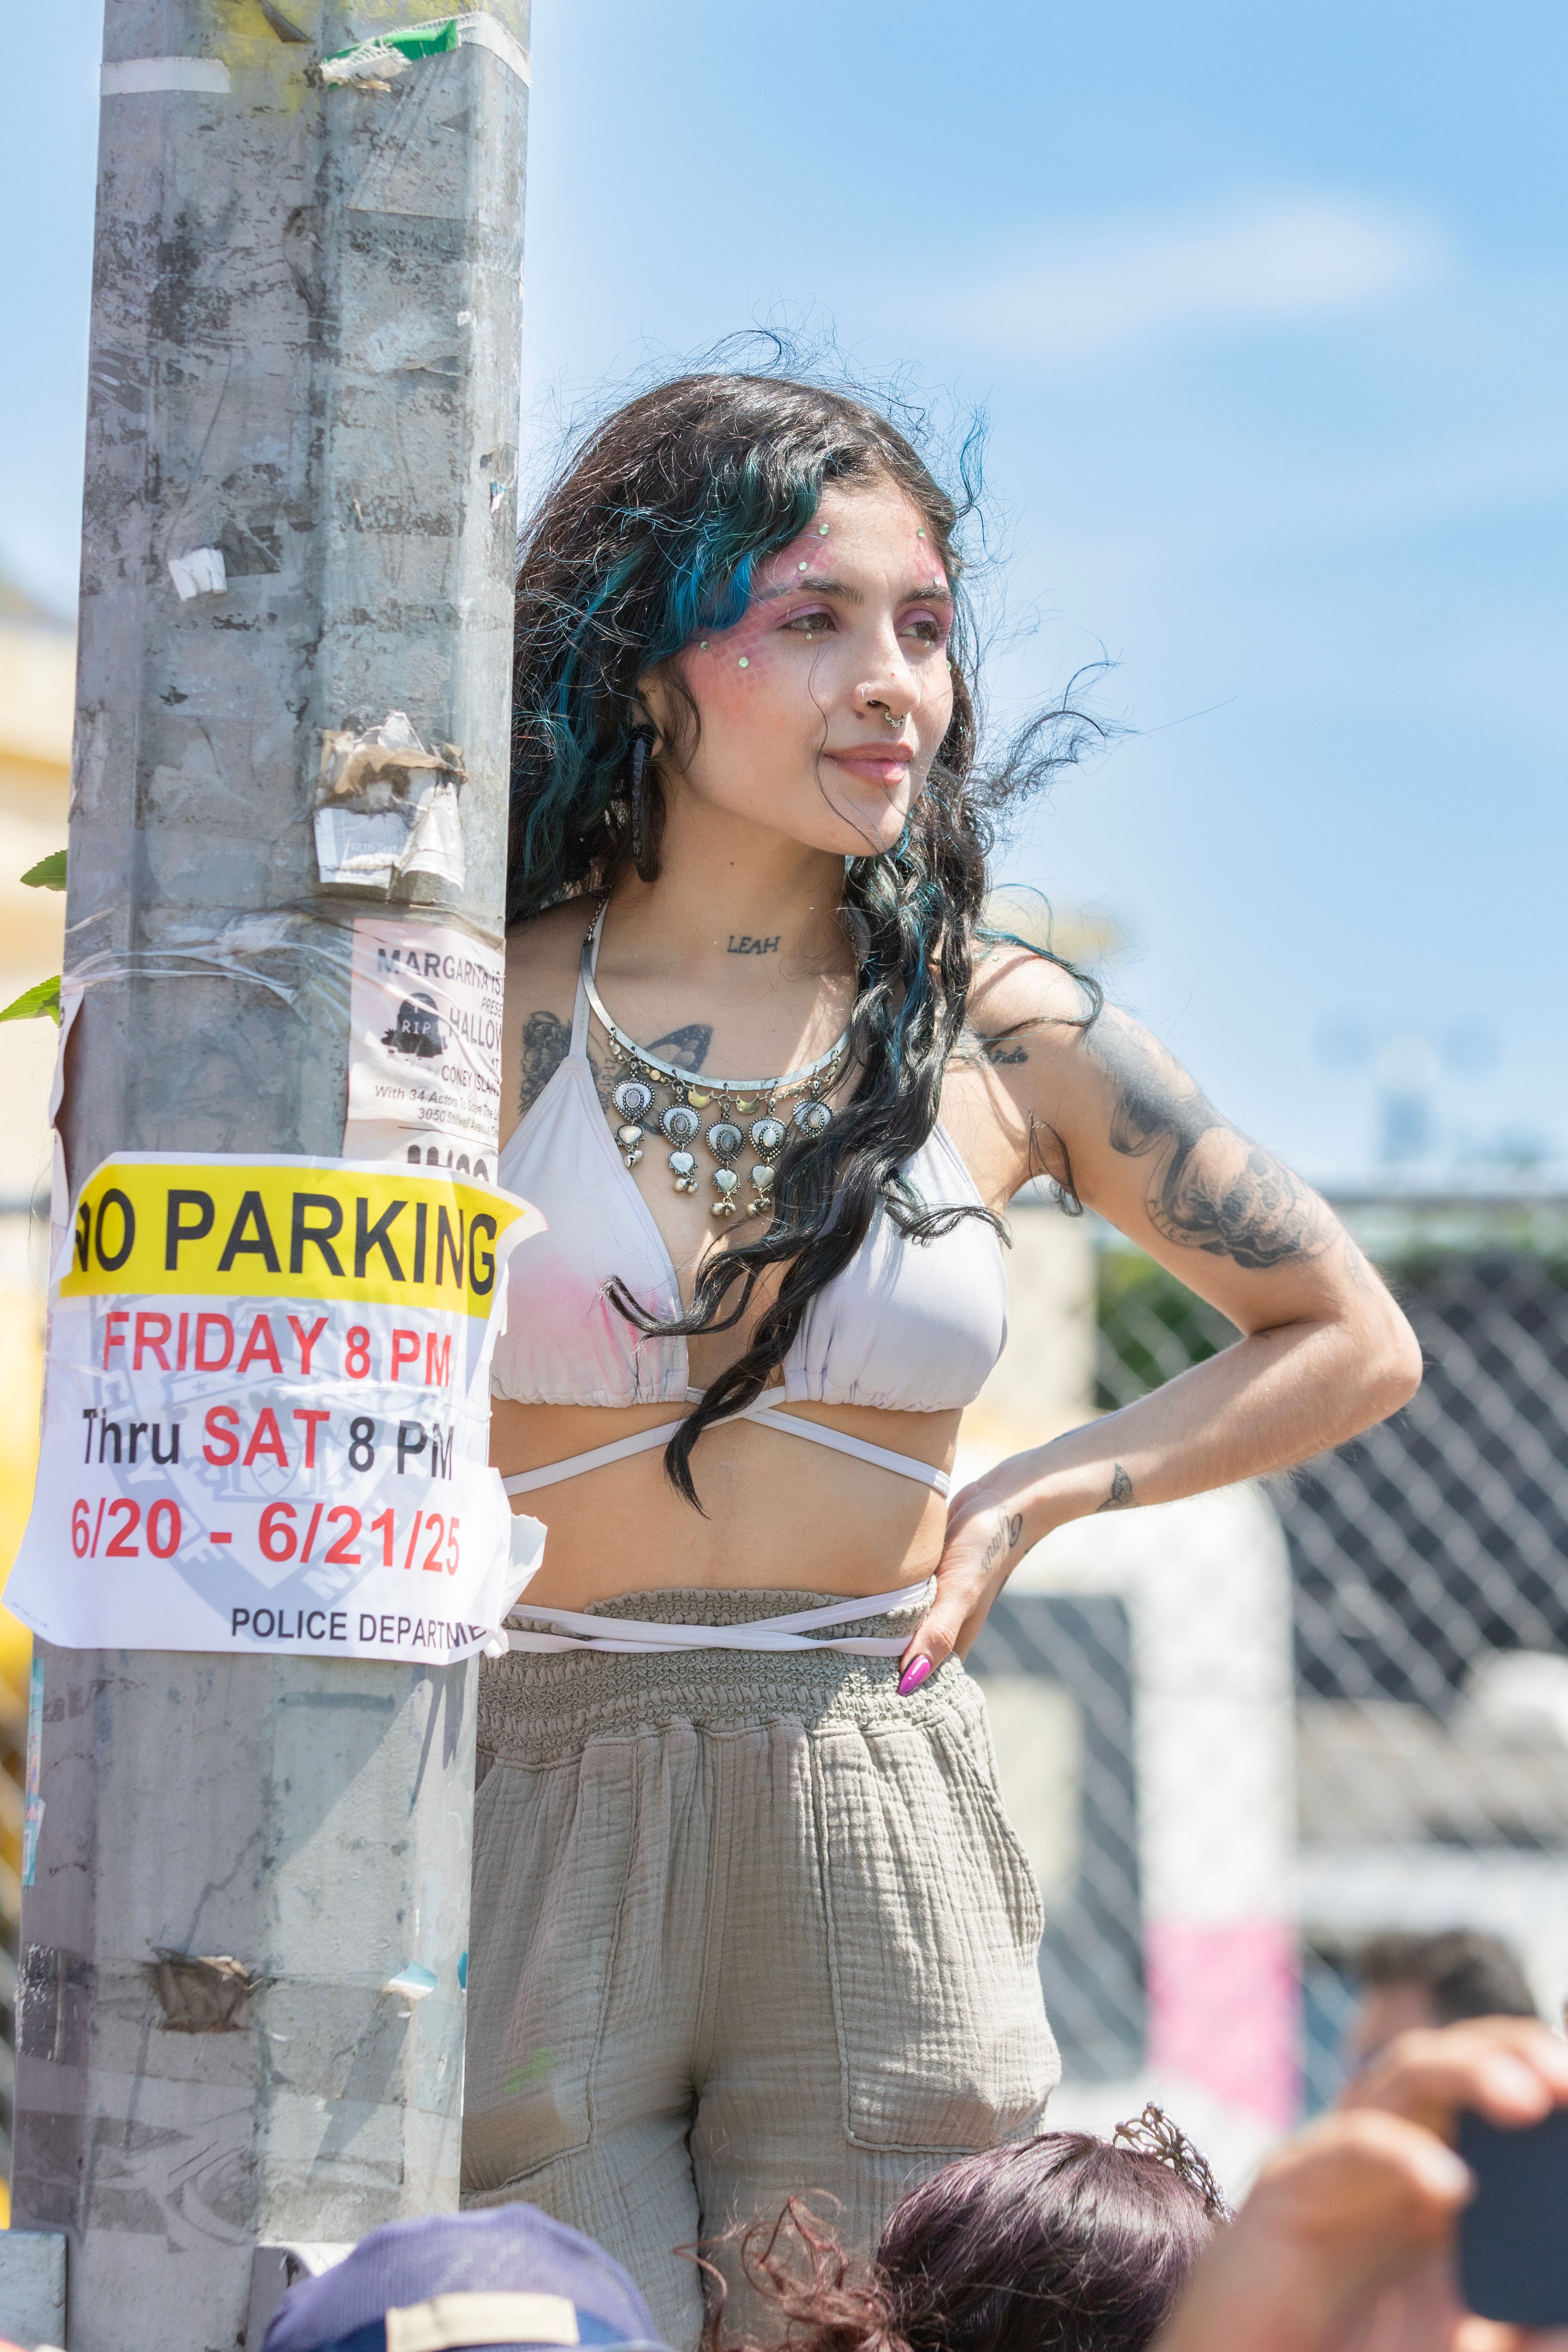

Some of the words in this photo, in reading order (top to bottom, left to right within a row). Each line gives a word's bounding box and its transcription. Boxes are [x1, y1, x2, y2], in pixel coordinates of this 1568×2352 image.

[727, 935, 781, 954] LEAH
[377, 948, 488, 993] MARGARITA
[481, 996, 503, 1018] PRESE
[402, 1019, 431, 1035] RIP
[442, 1065, 473, 1087] CONEY
[375, 1085, 405, 1100] With
[409, 1089, 425, 1101] 34
[429, 1091, 458, 1108] Actors
[459, 1097, 466, 1110] To
[483, 1105, 493, 1119] The
[418, 1107, 446, 1122] 3050
[164, 1189, 497, 1296] PARKING
[103, 1311, 329, 1375] FRIDAY
[345, 1325, 370, 1379] 8
[391, 1329, 452, 1387] PM
[83, 1407, 181, 1466] Thru
[202, 1405, 331, 1469] SAT
[349, 1416, 375, 1472] 8
[397, 1419, 454, 1481] PM
[71, 1497, 182, 1559] 6/20
[210, 1532, 232, 1544] -
[258, 1502, 460, 1576] 6/21/25
[231, 1607, 347, 1641] POLICE
